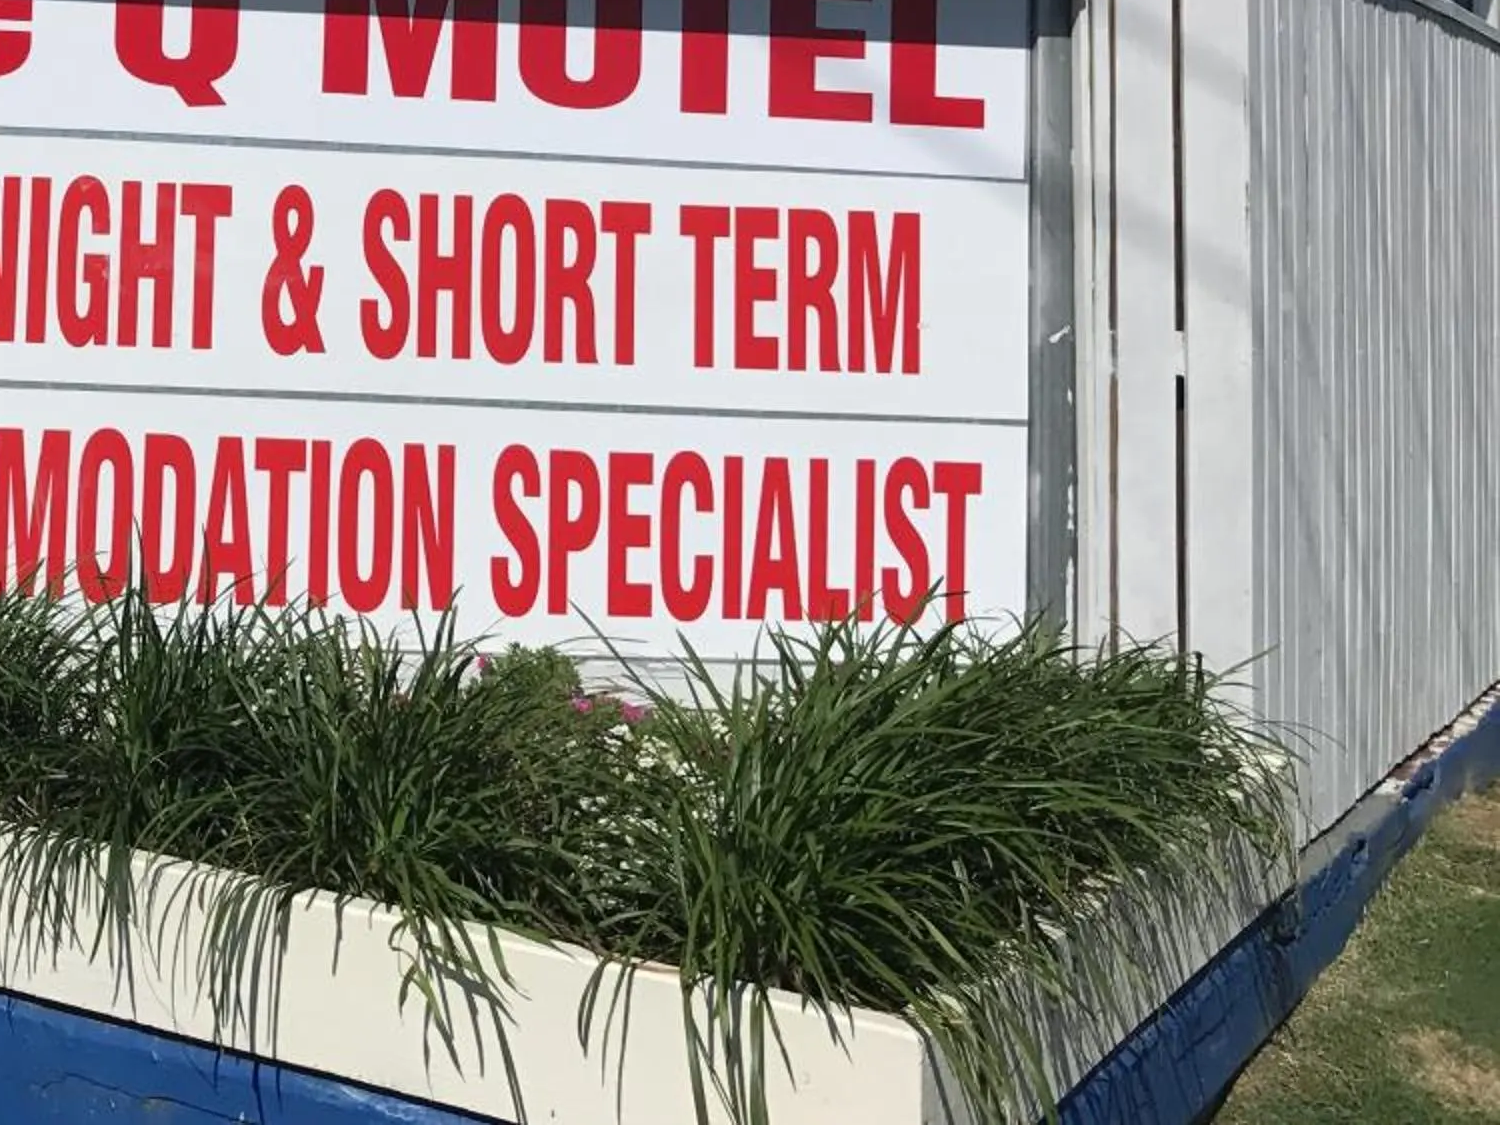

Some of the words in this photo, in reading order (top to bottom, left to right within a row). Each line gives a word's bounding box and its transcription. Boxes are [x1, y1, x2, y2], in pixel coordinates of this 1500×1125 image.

[262, 184, 325, 356] &
[360, 188, 652, 366] SHORT
[680, 204, 921, 374] TERM
[491, 444, 982, 626] SPECIALIST
